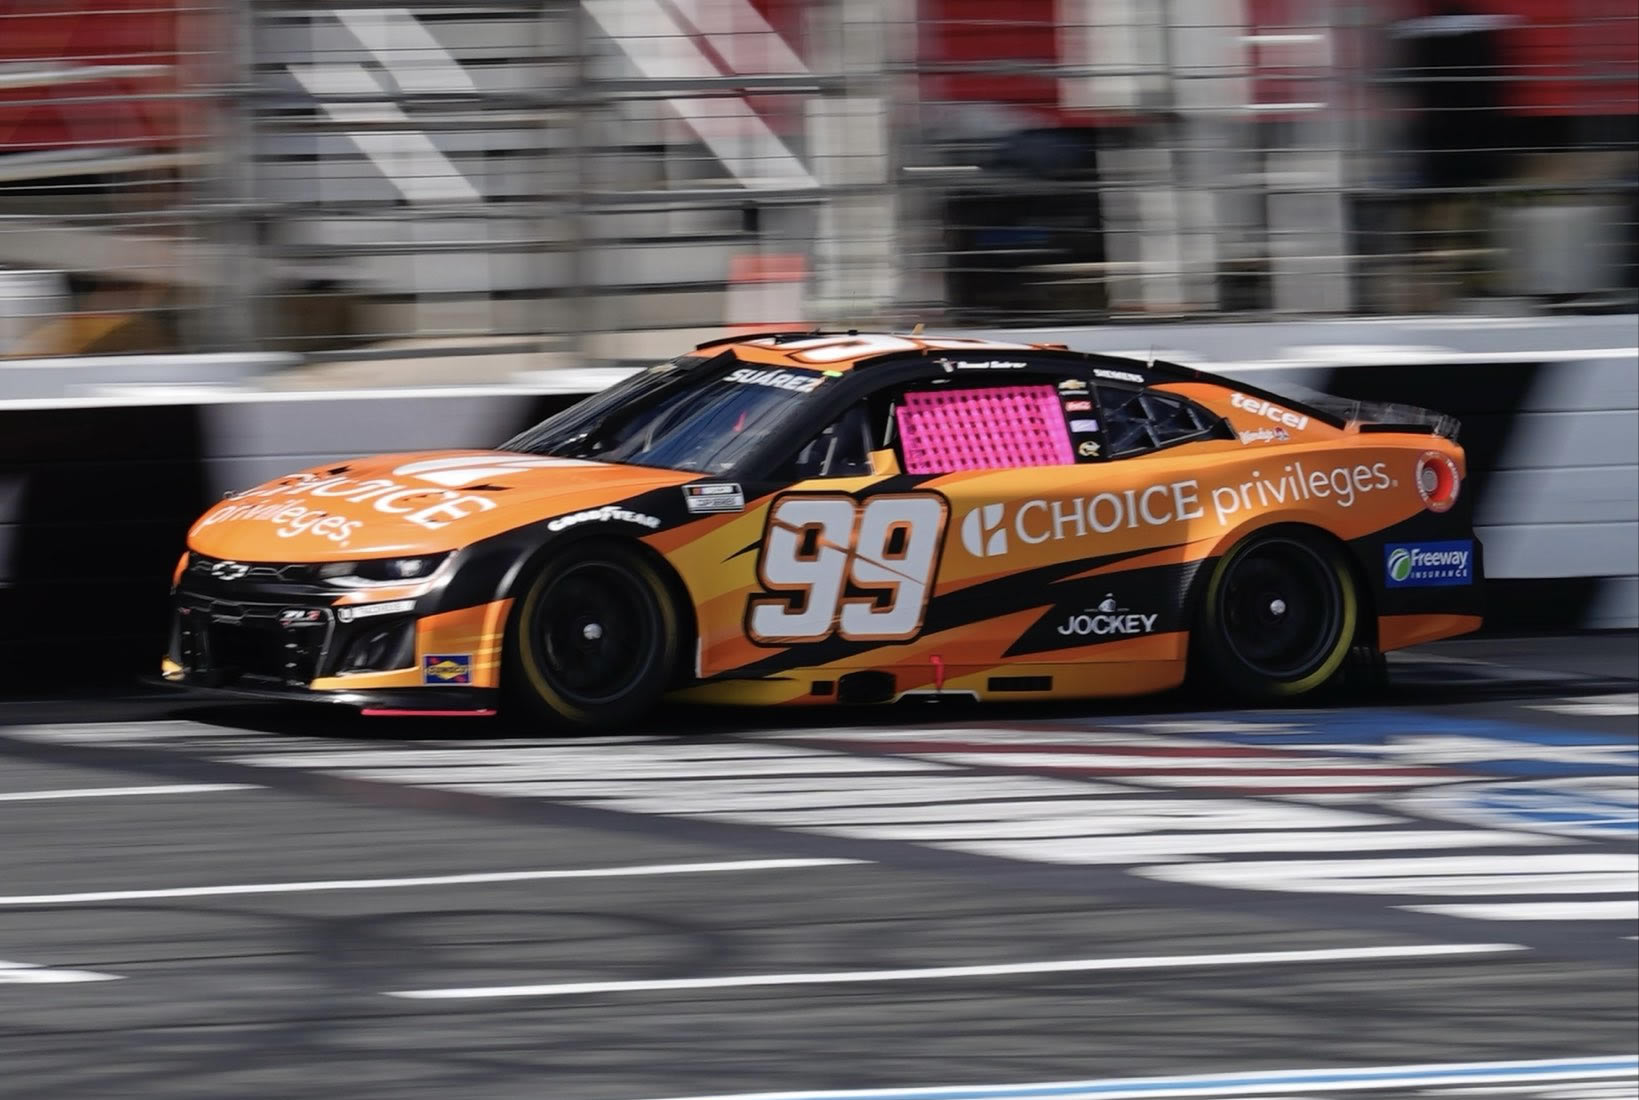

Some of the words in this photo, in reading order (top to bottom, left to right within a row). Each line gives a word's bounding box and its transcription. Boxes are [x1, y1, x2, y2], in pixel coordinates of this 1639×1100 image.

[721, 368, 828, 393] SUÁREZ
[1231, 392, 1309, 430] telcel
[1015, 479, 1204, 545] CHOICE
[745, 491, 950, 644] 99
[1411, 548, 1469, 569] Freeway
[1410, 569, 1467, 579] INSURANCE
[1057, 614, 1158, 635] JOCKEY
